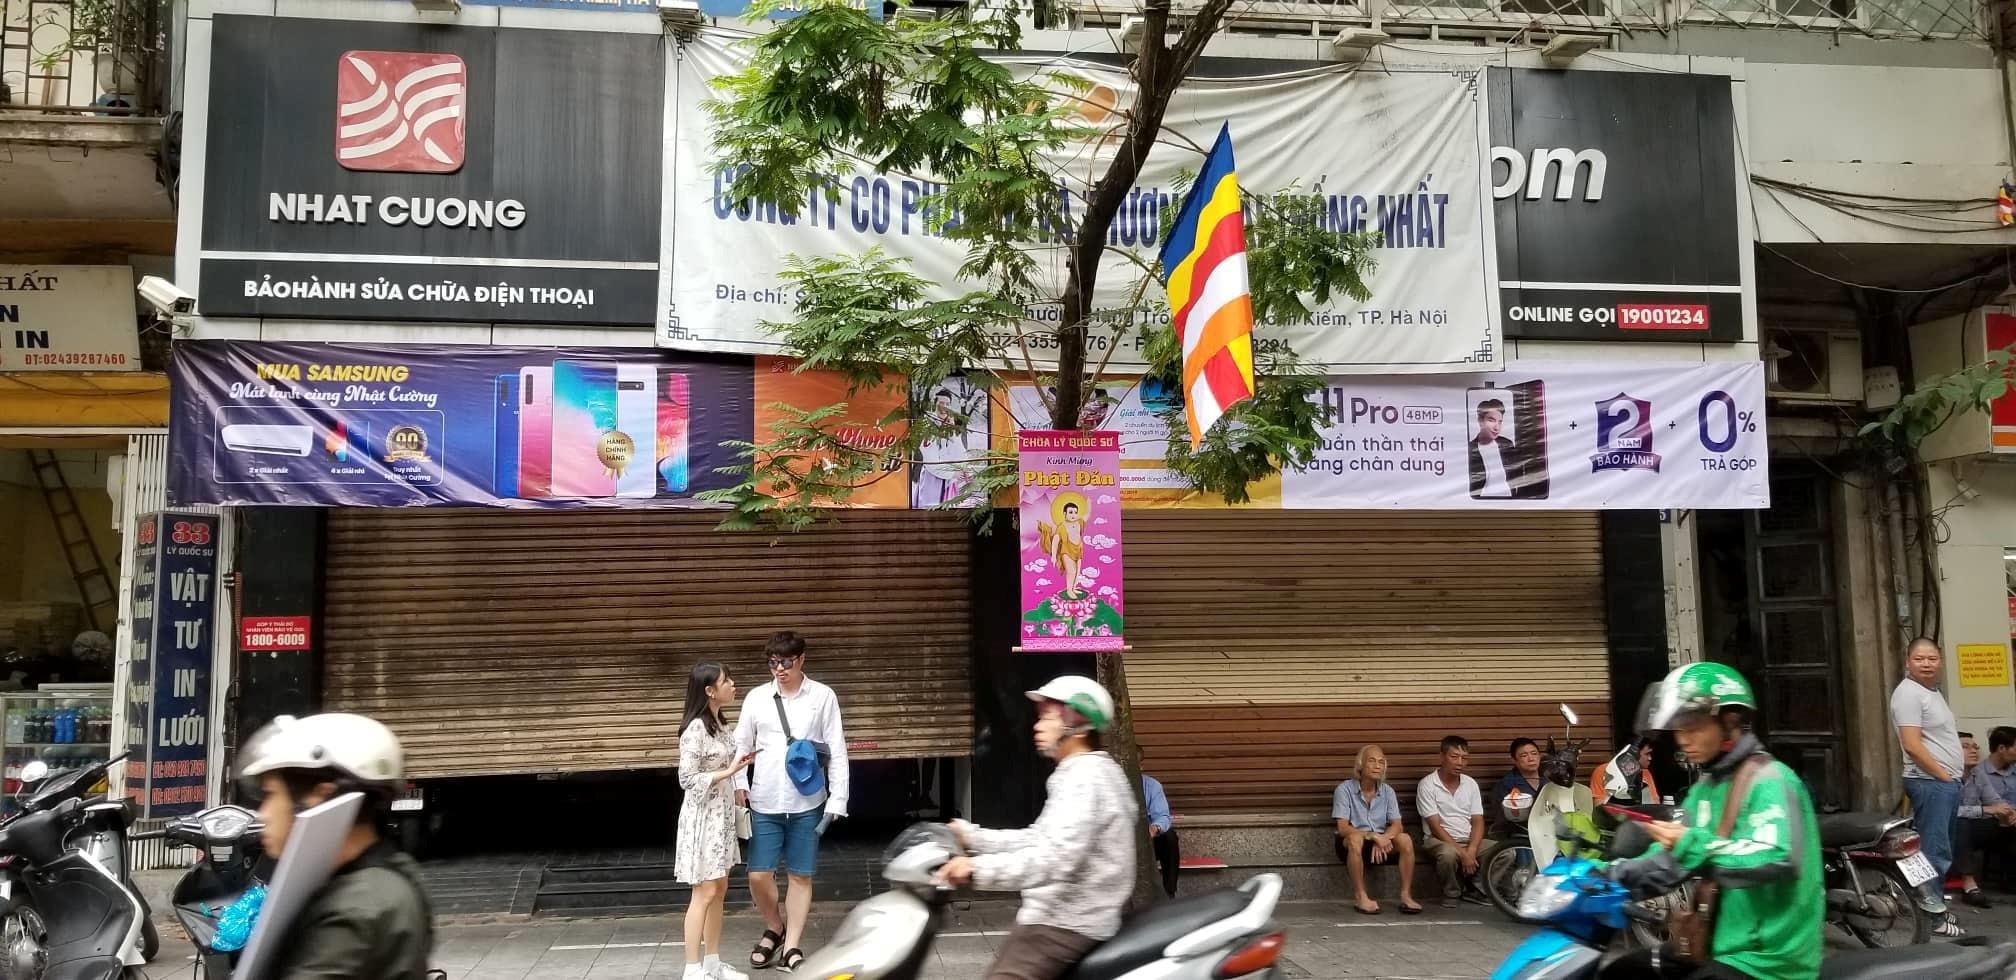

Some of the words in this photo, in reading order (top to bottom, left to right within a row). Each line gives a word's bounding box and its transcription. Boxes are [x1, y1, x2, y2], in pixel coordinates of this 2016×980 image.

[269, 192, 373, 224] NHAT
[378, 195, 527, 229] CUONG
[1377, 173, 1449, 249] NHẤT
[360, 277, 404, 301] SỬA
[407, 279, 470, 303] CHỮA
[473, 281, 524, 307] ĐIỆN
[529, 286, 594, 309] THOẠI
[716, 283, 746, 304] Địa
[1358, 311, 1384, 326] TP.
[1391, 310, 1413, 325] Hà
[1420, 310, 1448, 328] Nội
[1508, 305, 1574, 323] ONLINE
[1578, 307, 1616, 328] GỌI
[1620, 308, 1706, 325] 19001234
[15, 330, 49, 349] IN
[256, 363, 301, 381] MUA
[306, 363, 410, 383] SAMSUNG
[229, 382, 266, 400] Mát
[303, 388, 341, 407] cùng
[344, 384, 386, 405] Nhật
[388, 385, 439, 408] Cường
[1351, 396, 1399, 424] Pro
[1405, 409, 1440, 421] 48MP
[1607, 400, 1640, 447] 2
[1362, 433, 1404, 451] thần
[1410, 436, 1445, 451] thái
[1349, 455, 1394, 471] chân
[1400, 456, 1445, 476] dung
[1622, 451, 1655, 466] HÀNH
[1701, 454, 1727, 471] TRẢ
[1729, 455, 1757, 471] GÓP
[1023, 470, 1071, 490] Phật
[171, 521, 210, 545] 33
[170, 567, 209, 608] VẬT
[174, 618, 203, 650] TƯ
[245, 633, 306, 647] 1800-6009
[173, 668, 196, 698] IN
[158, 707, 206, 748] LƯỚI
